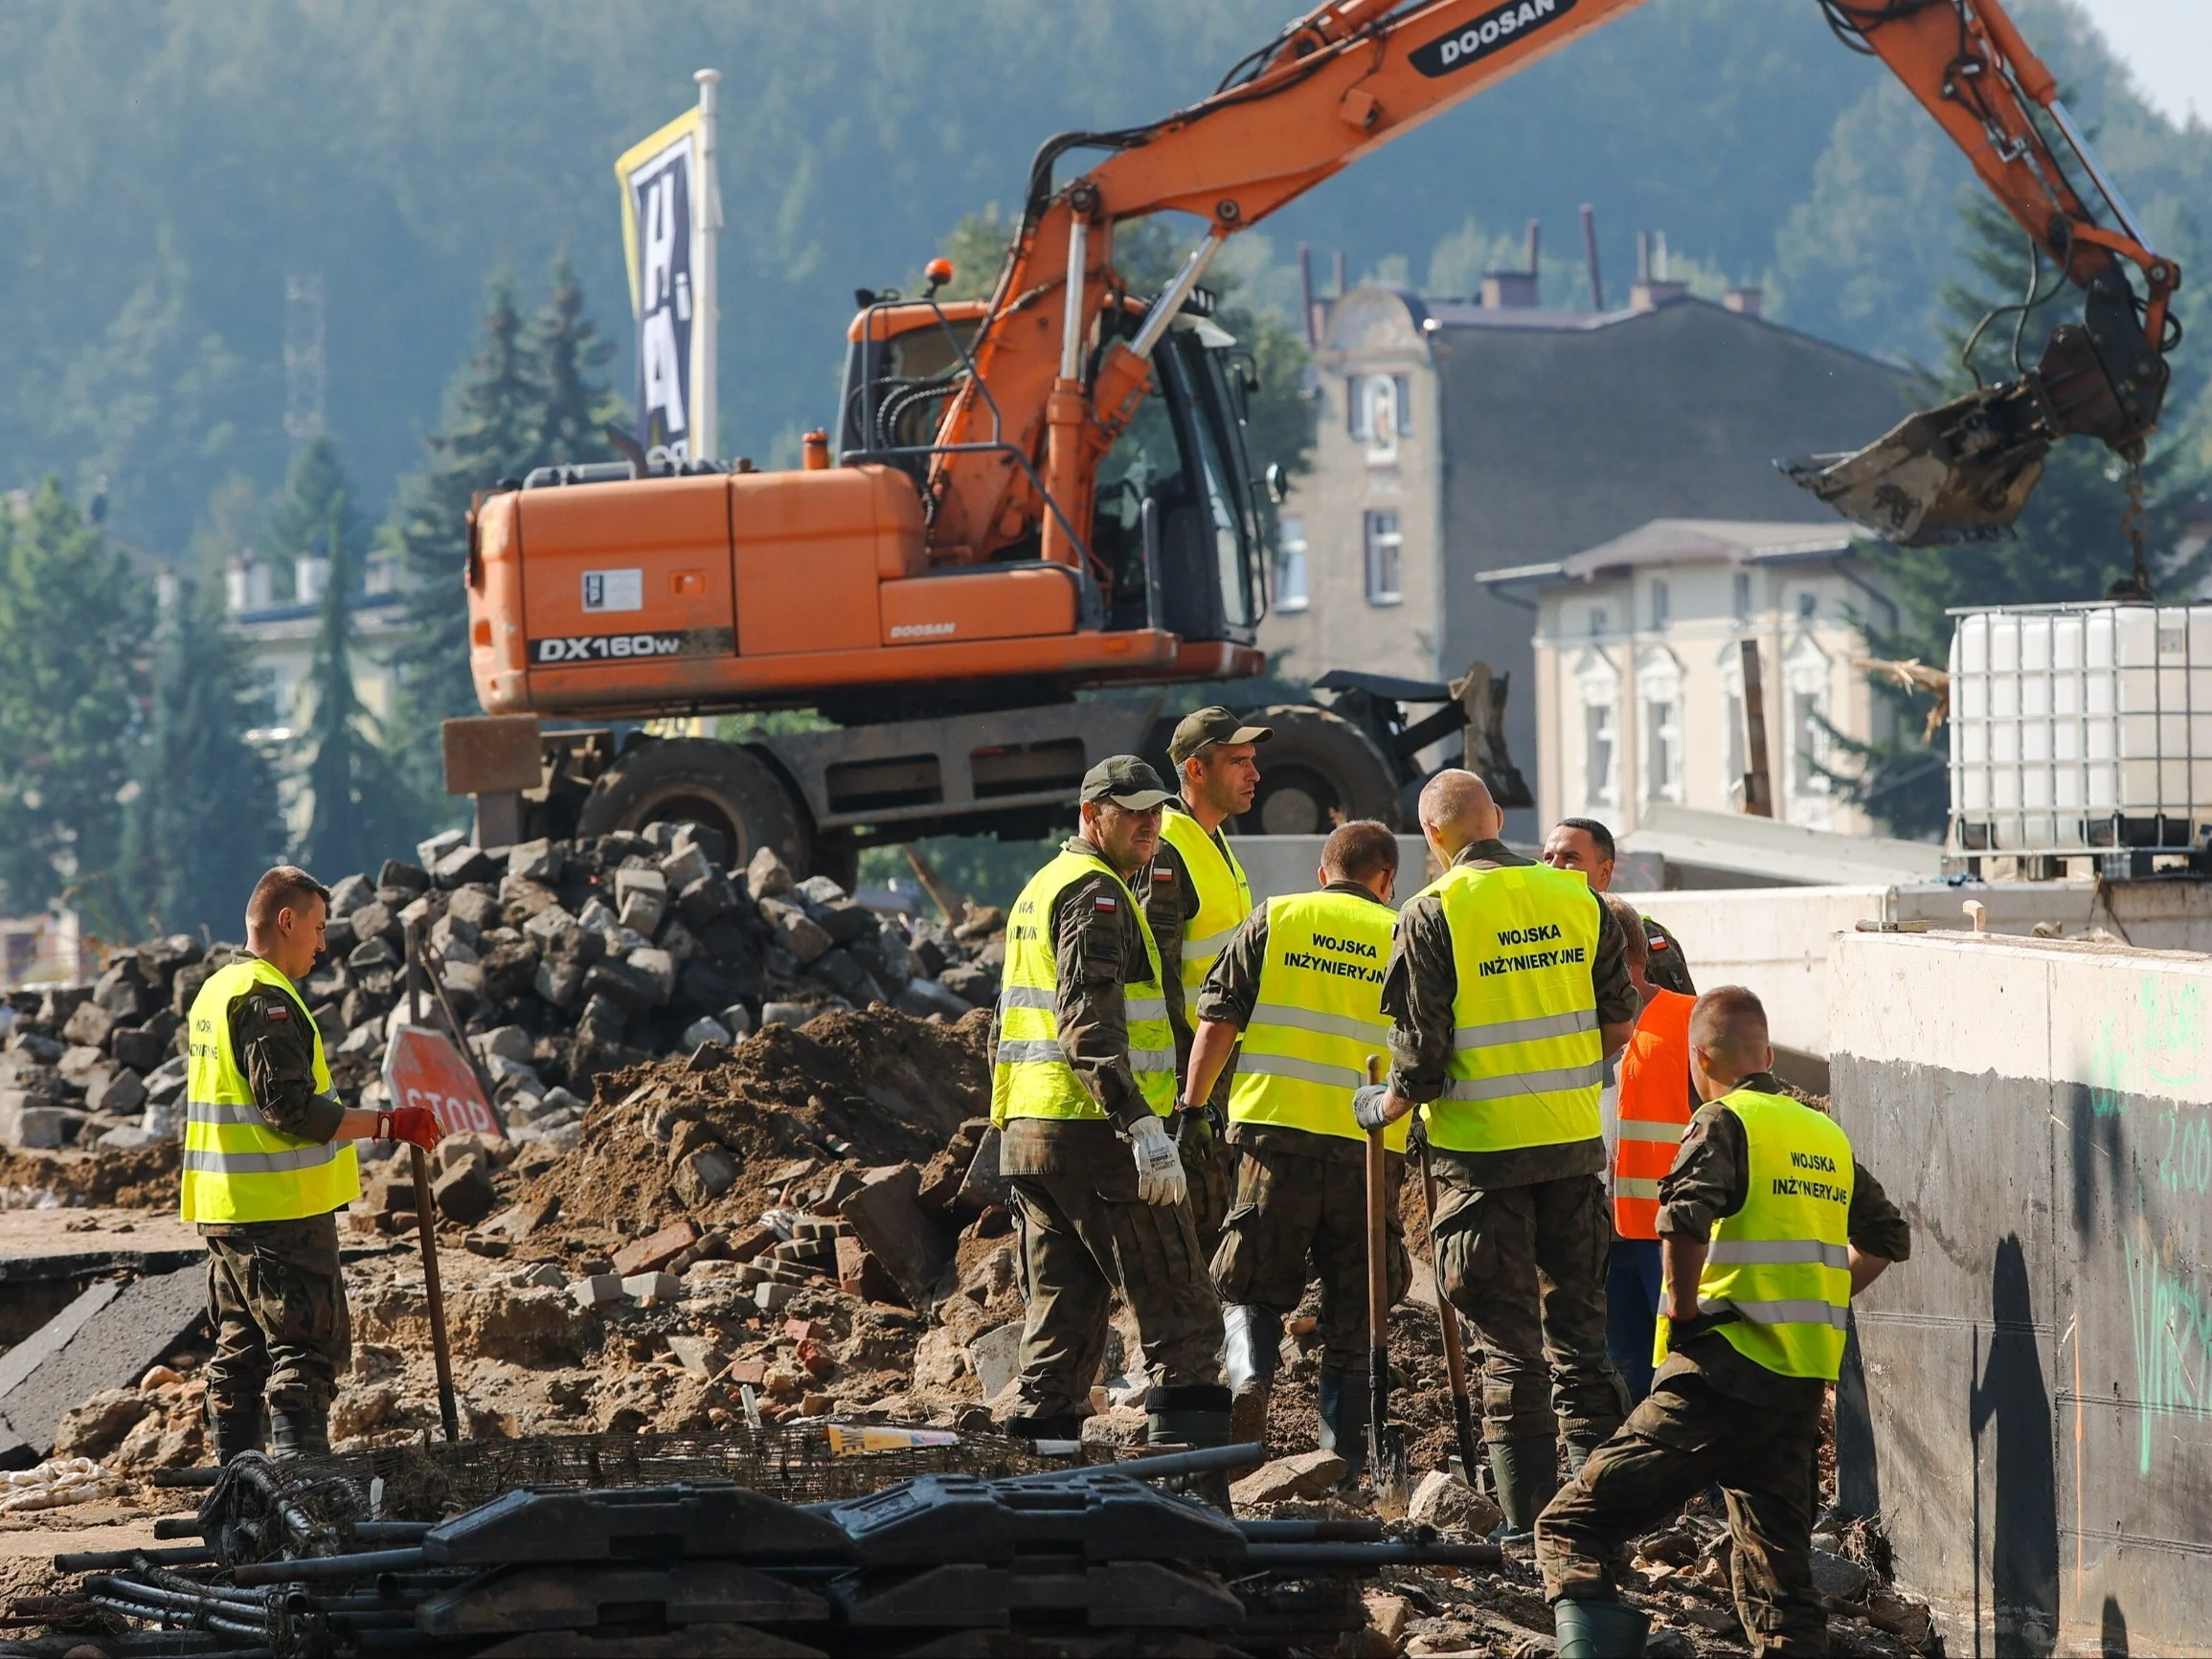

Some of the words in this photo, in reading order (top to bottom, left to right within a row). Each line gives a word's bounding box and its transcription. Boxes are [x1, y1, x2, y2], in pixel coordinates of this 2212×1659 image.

[1440, 0, 1555, 65] DOOSAN
[1313, 932, 1377, 958] WOJSKA
[1497, 924, 1562, 947] WOJSKA
[1284, 952, 1388, 985] INŻYNIERYJN
[1478, 948, 1585, 976] INŻYNIERYJNE
[1790, 1152, 1837, 1174] WOJSKA
